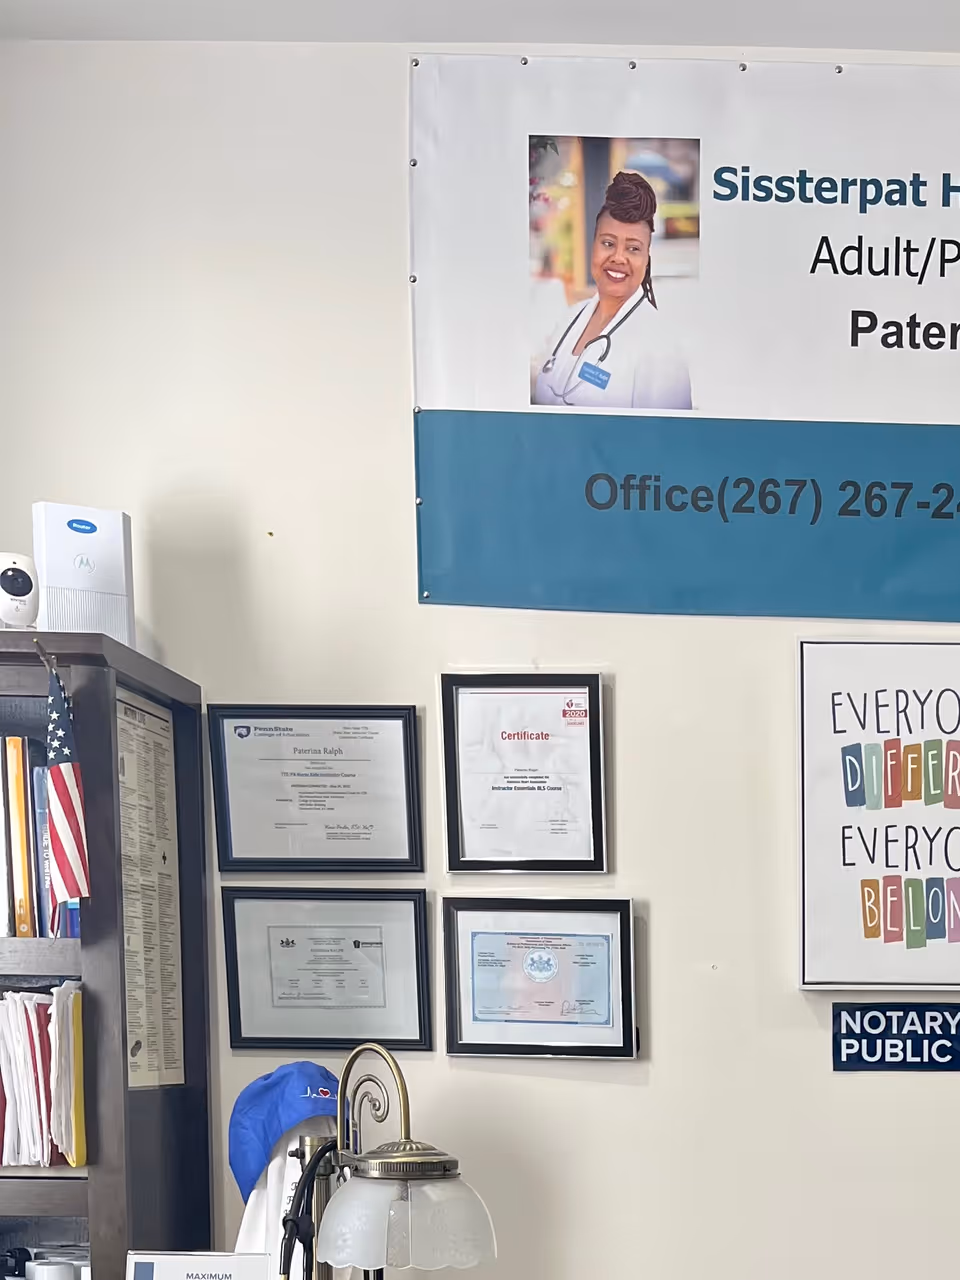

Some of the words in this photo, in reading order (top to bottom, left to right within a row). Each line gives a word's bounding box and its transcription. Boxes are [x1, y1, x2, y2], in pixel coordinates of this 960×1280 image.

[713, 166, 926, 214] Sissterpat
[584, 473, 822, 525] Office(267)
[501, 731, 549, 740] Certificate
[323, 747, 343, 756] Ralph
[840, 1039, 952, 1063] PUBLIC
